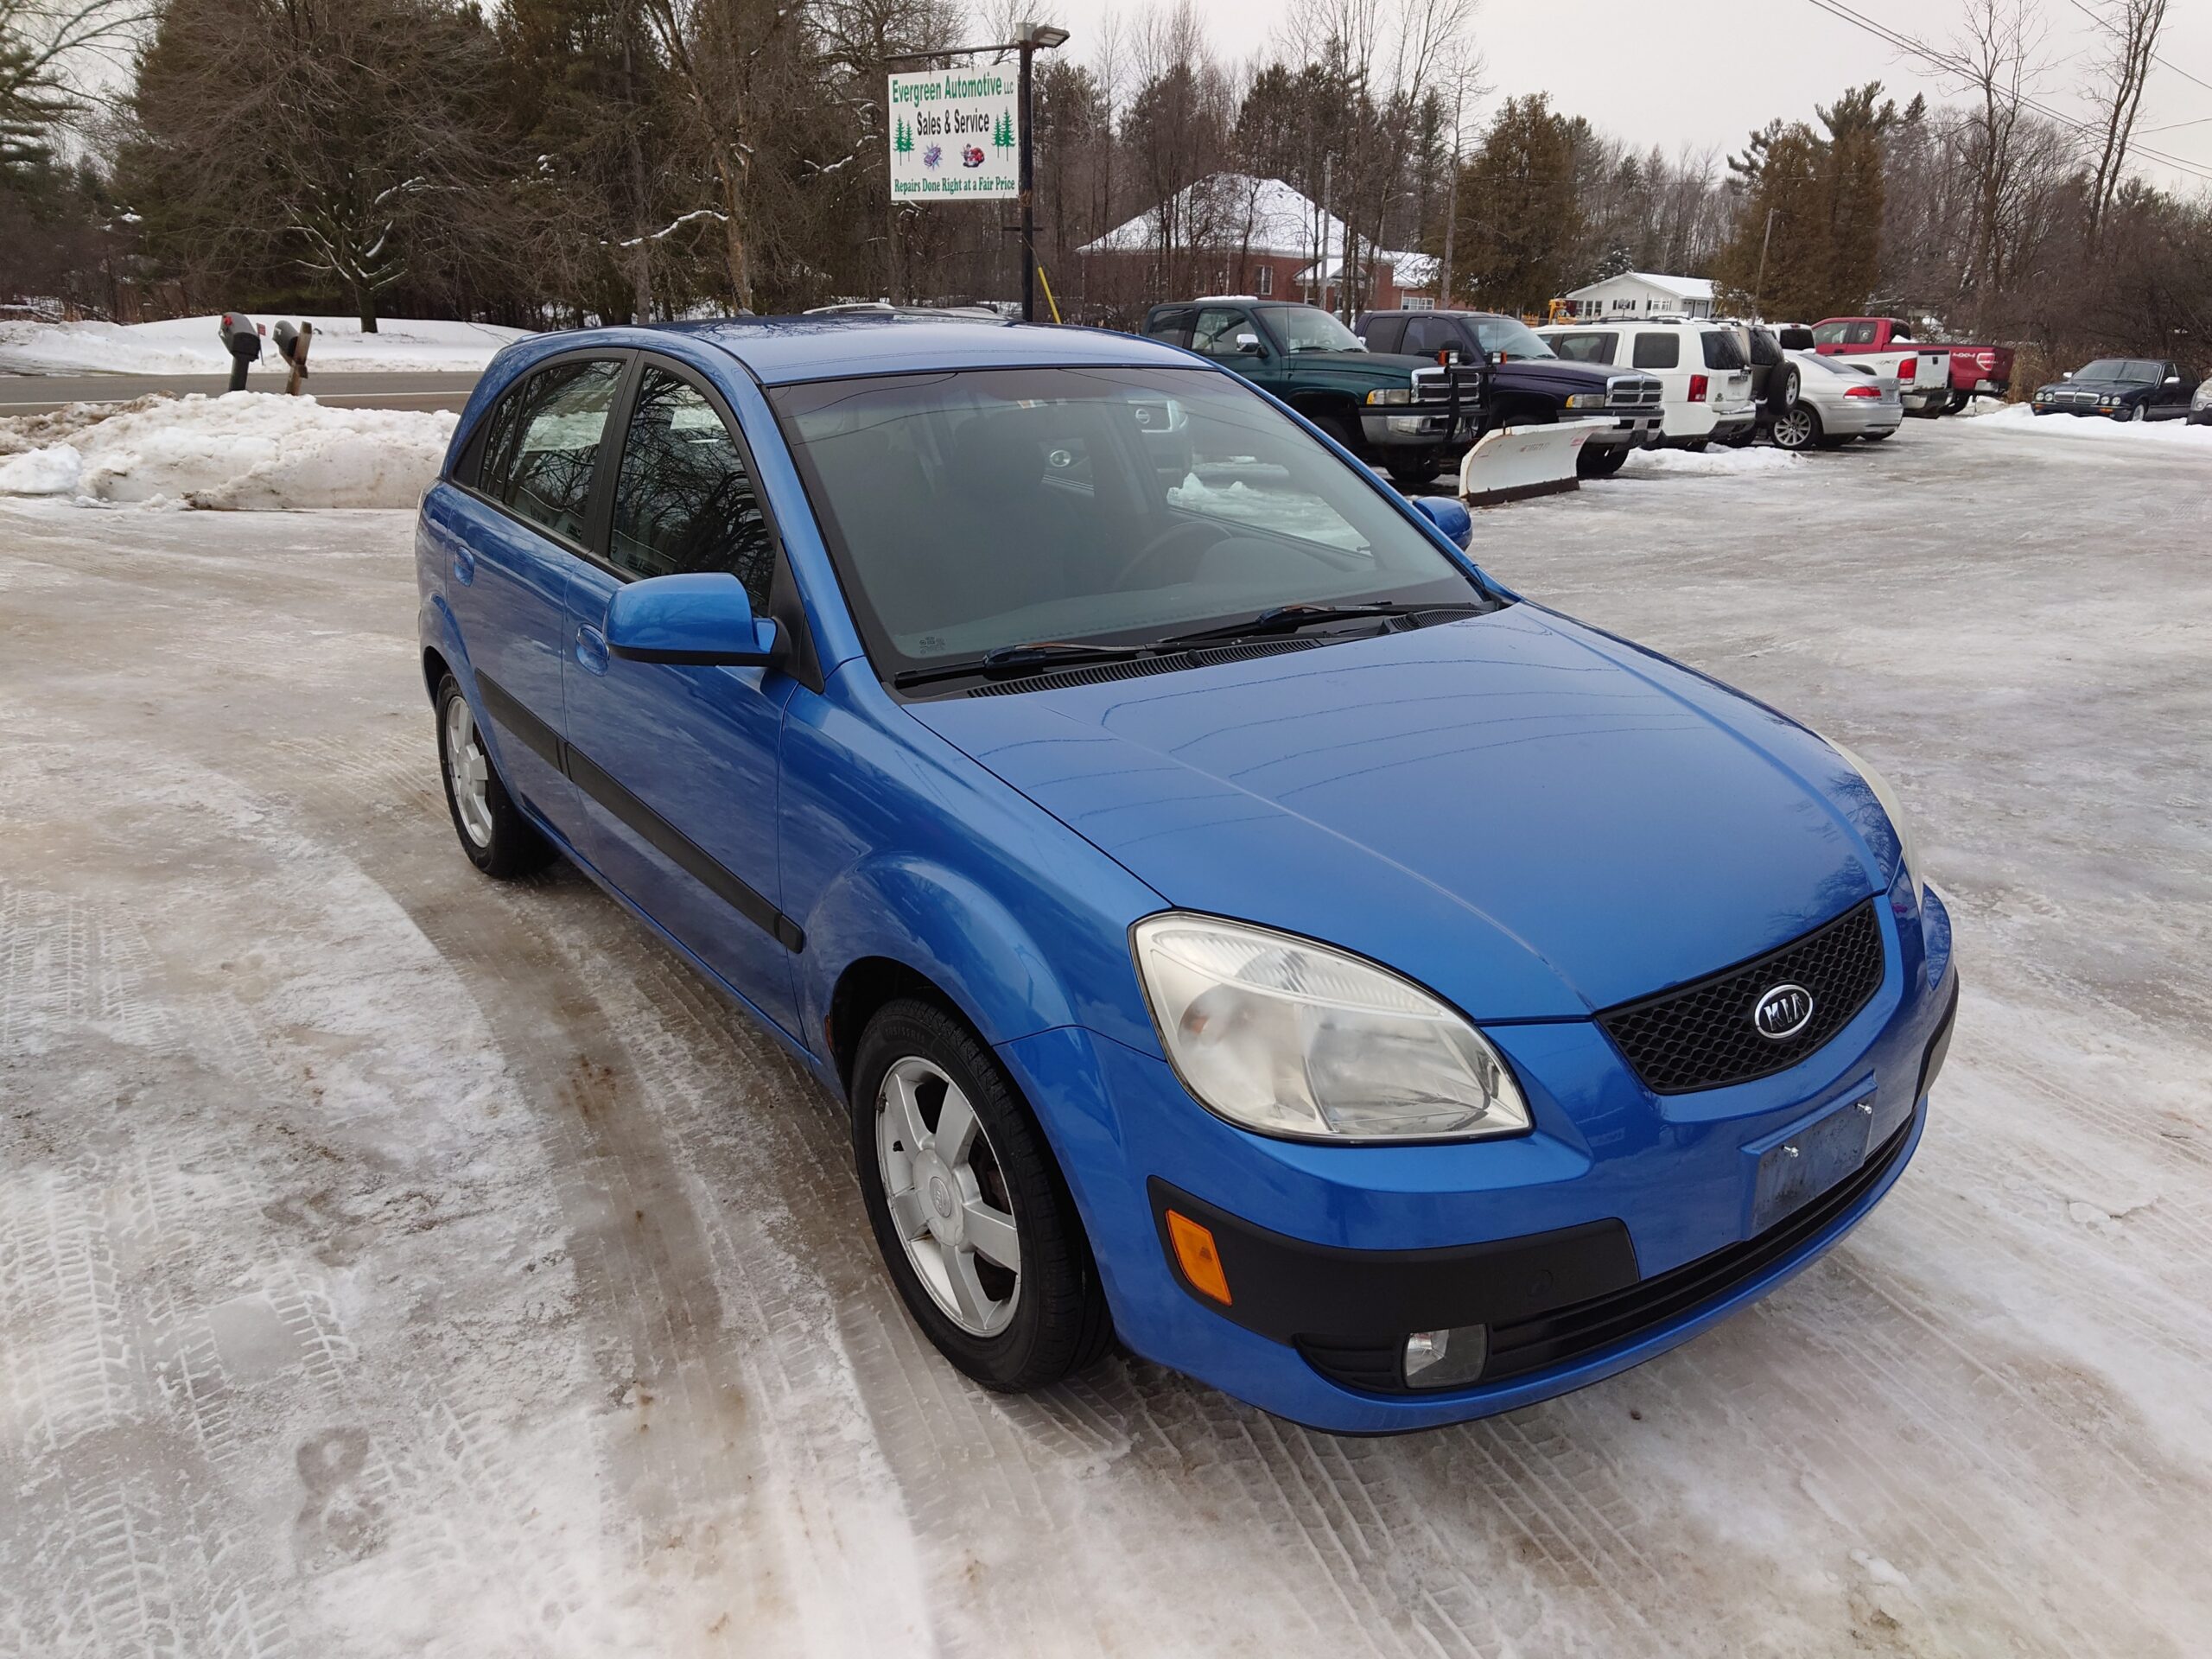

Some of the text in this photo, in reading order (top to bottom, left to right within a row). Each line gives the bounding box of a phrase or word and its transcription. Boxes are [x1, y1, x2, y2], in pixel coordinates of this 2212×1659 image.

[893, 72, 1014, 108] Evergreen Automotive LLC
[917, 108, 989, 136] Sales & Service
[894, 175, 1015, 195] Repairs Done Right at a Fair Price
[1764, 993, 1806, 1031] KIA
